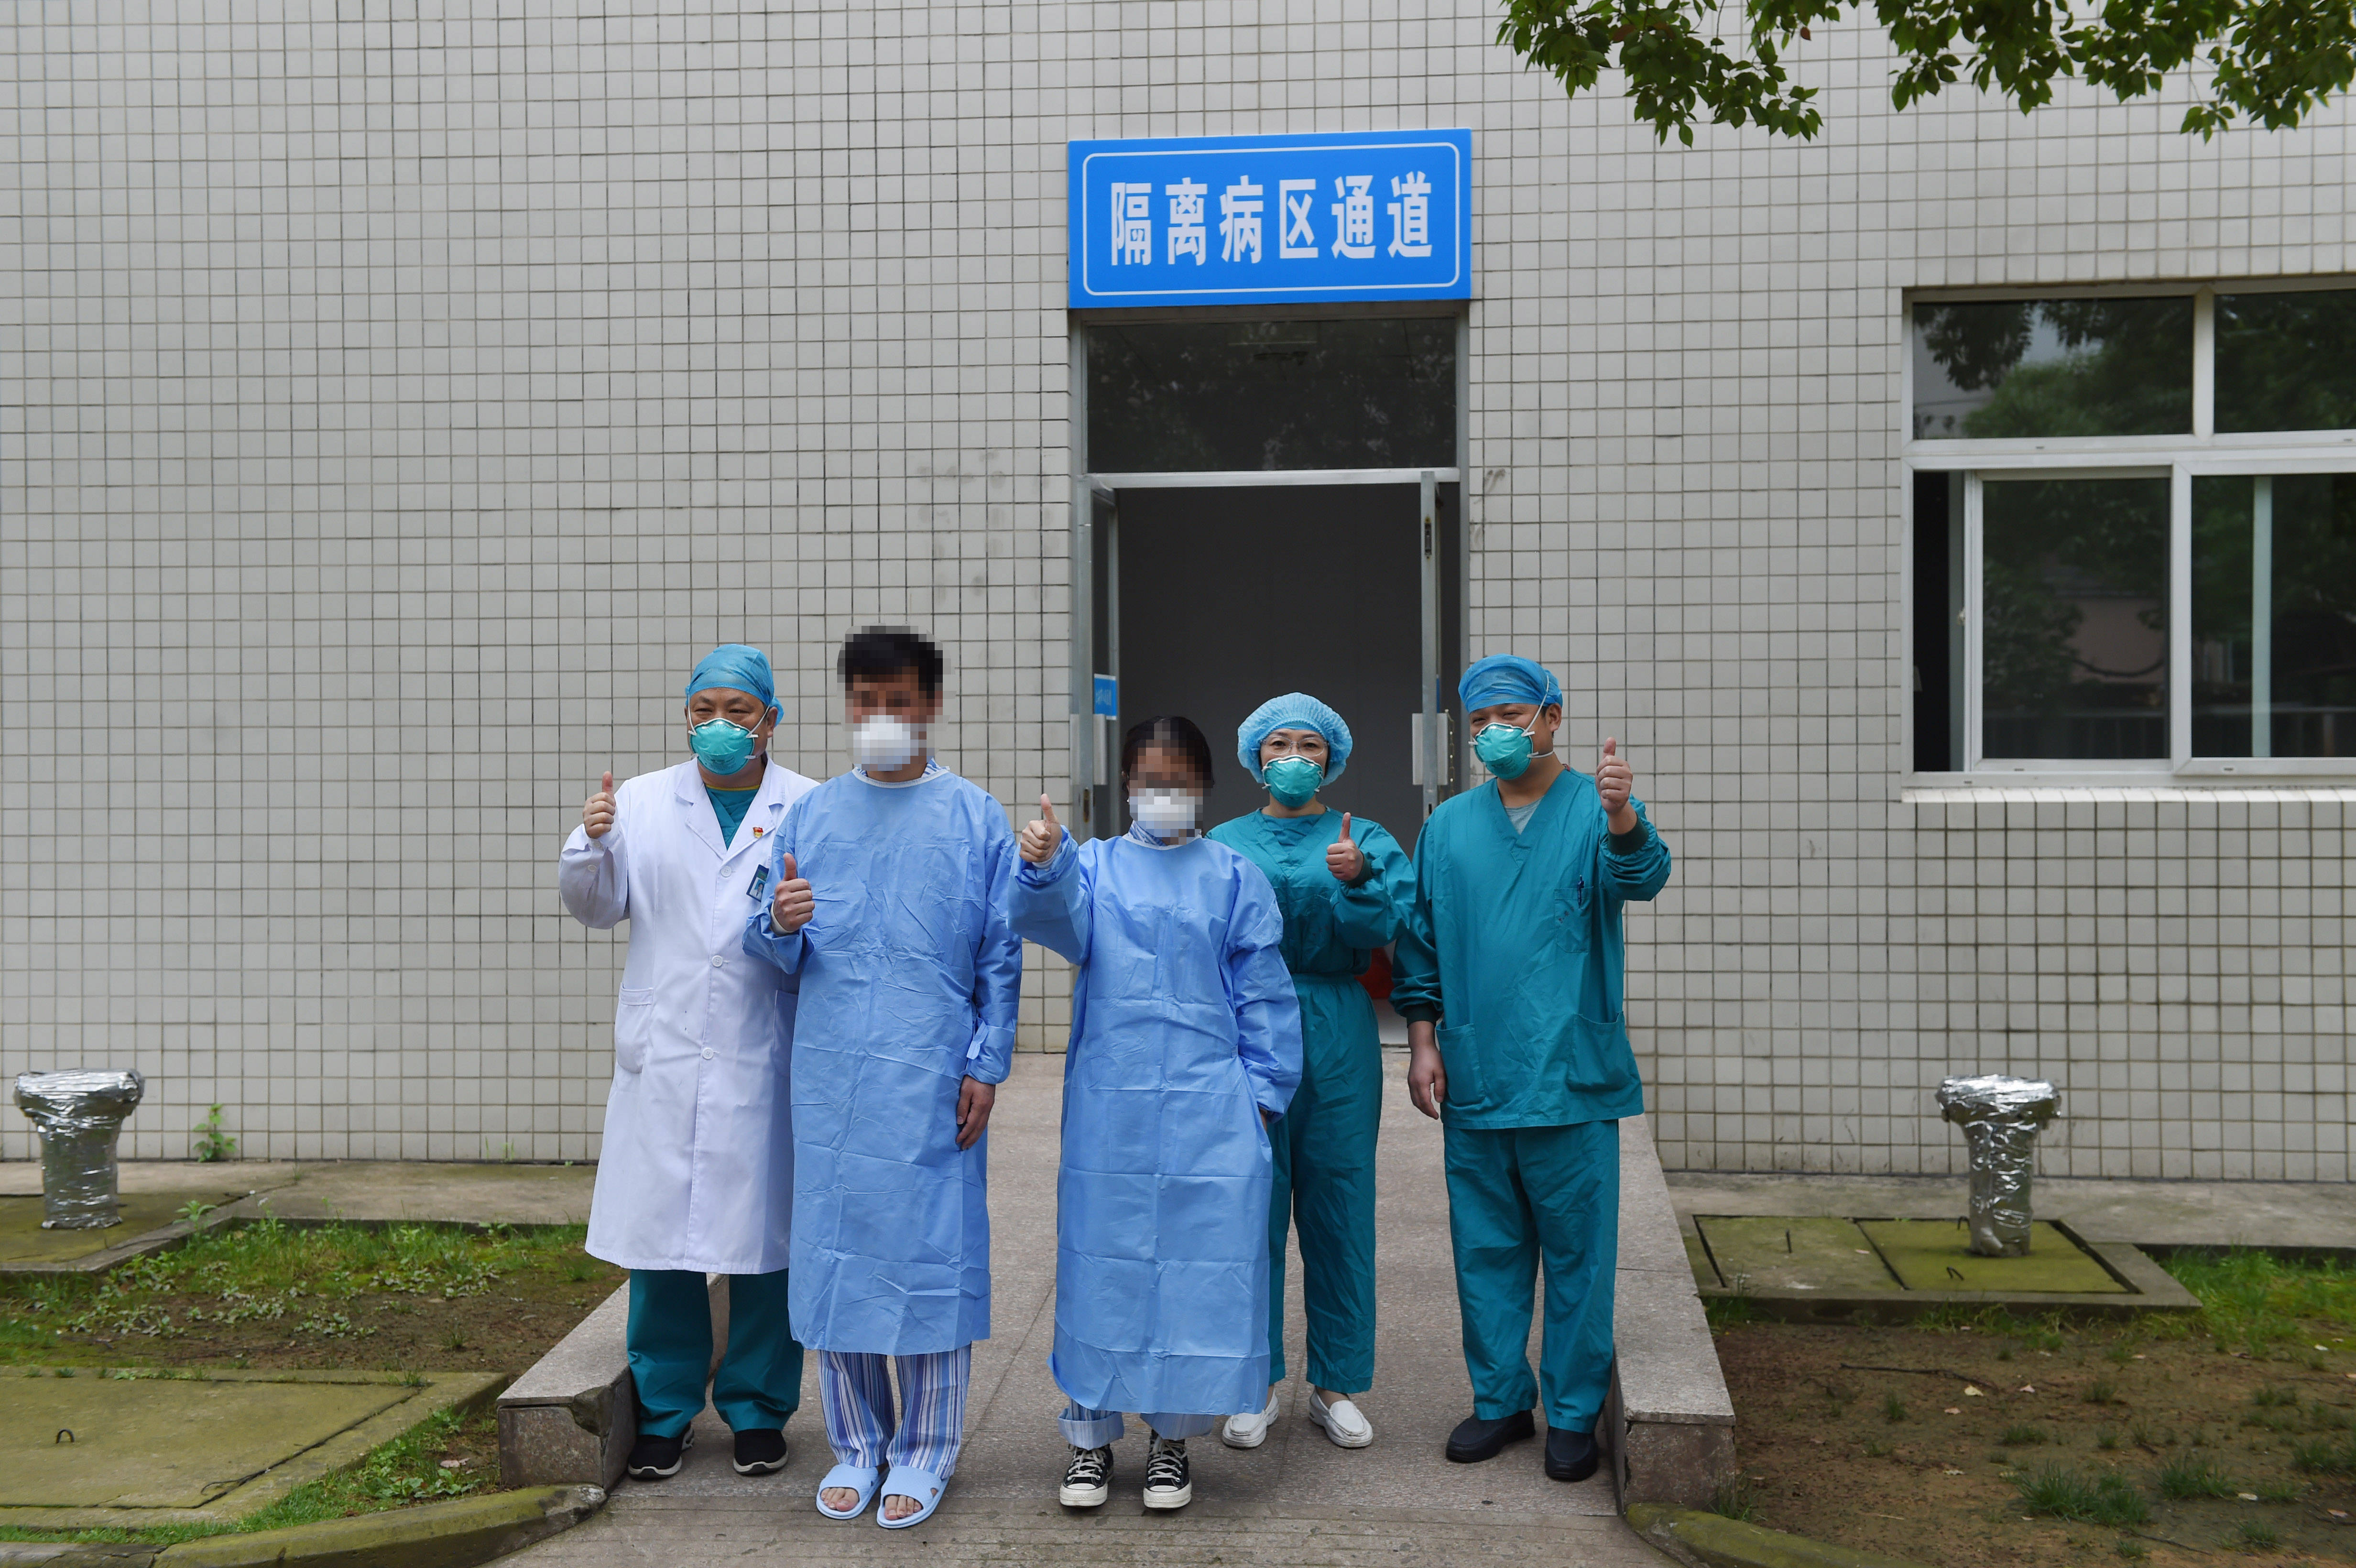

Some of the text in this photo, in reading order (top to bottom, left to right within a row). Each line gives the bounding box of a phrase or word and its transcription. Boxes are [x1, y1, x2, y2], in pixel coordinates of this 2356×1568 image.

[1111, 171, 1433, 266] 隔离病区通道
